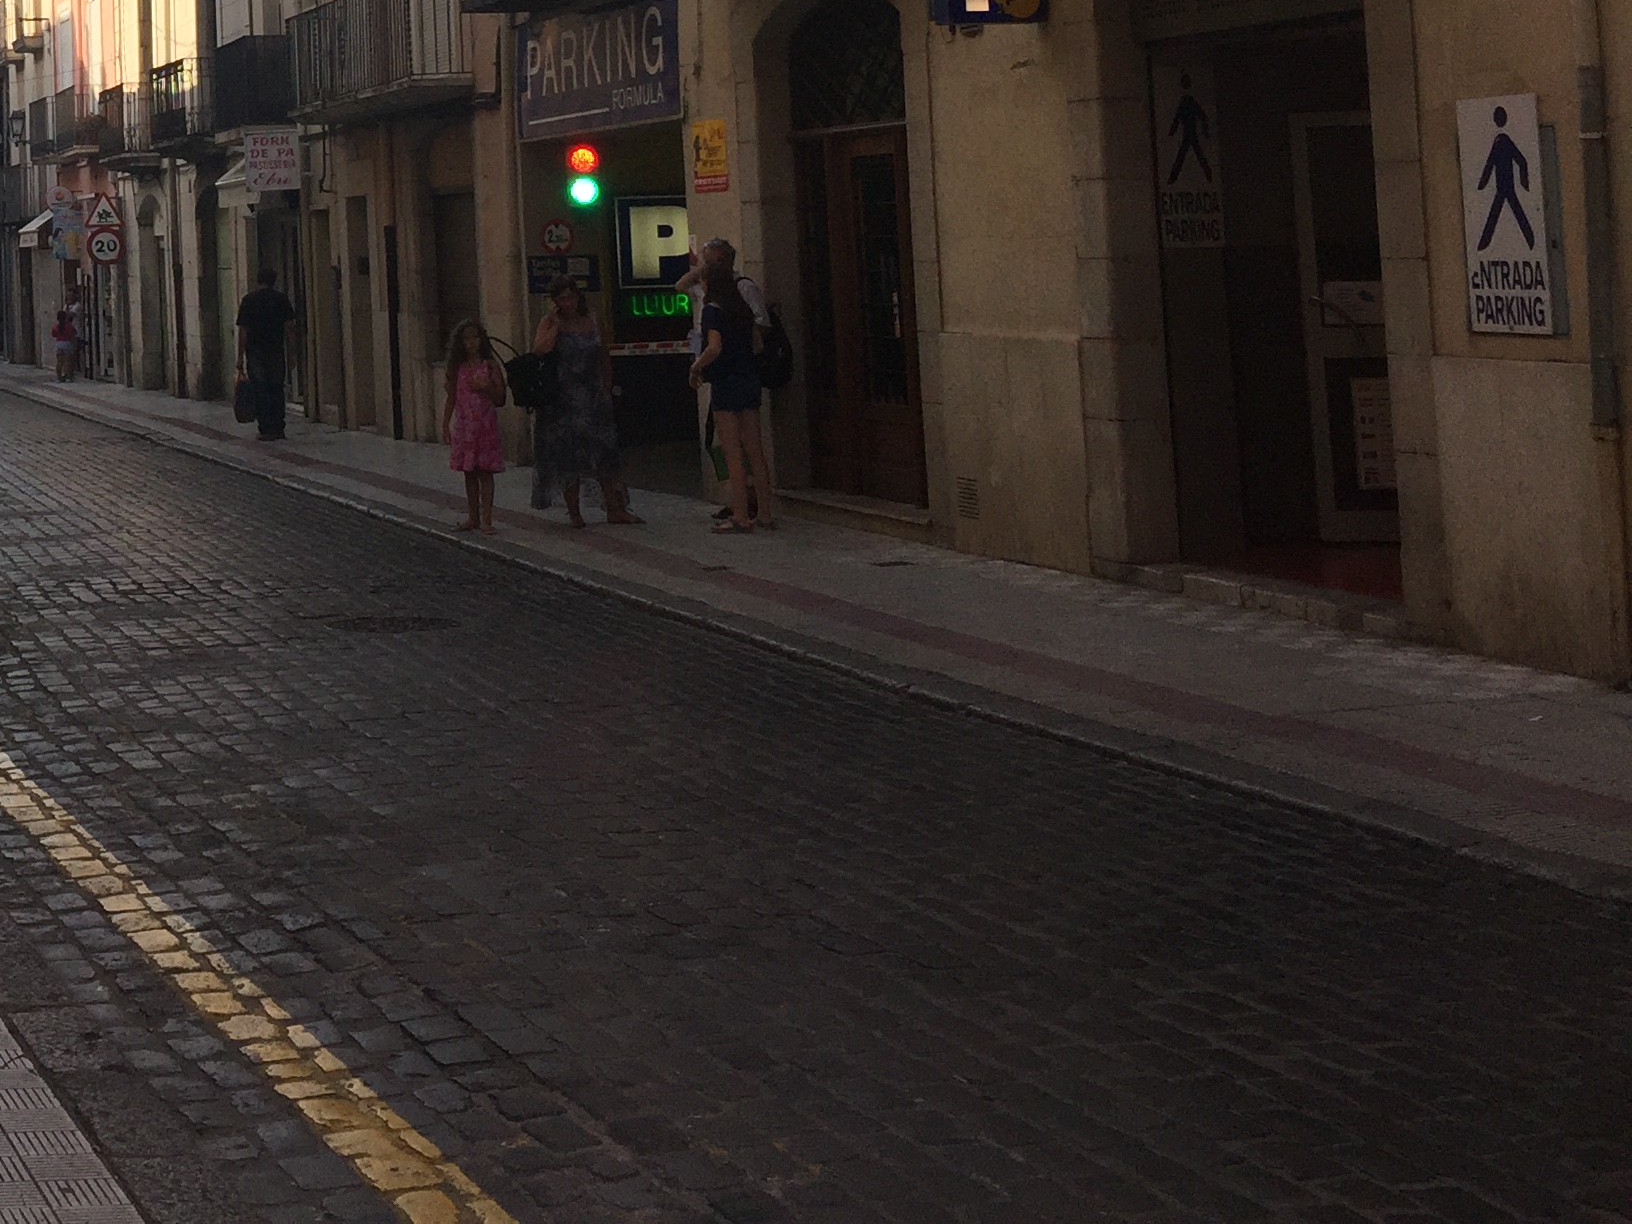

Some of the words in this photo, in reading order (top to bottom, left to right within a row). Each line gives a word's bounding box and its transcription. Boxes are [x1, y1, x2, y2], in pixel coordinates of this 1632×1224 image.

[526, 6, 665, 100] PARKING
[612, 81, 665, 110] FORMULA
[250, 149, 268, 159] DE
[277, 148, 294, 157] PA
[94, 240, 117, 253] 20
[629, 206, 690, 279] P
[1475, 295, 1546, 326] PARKING
